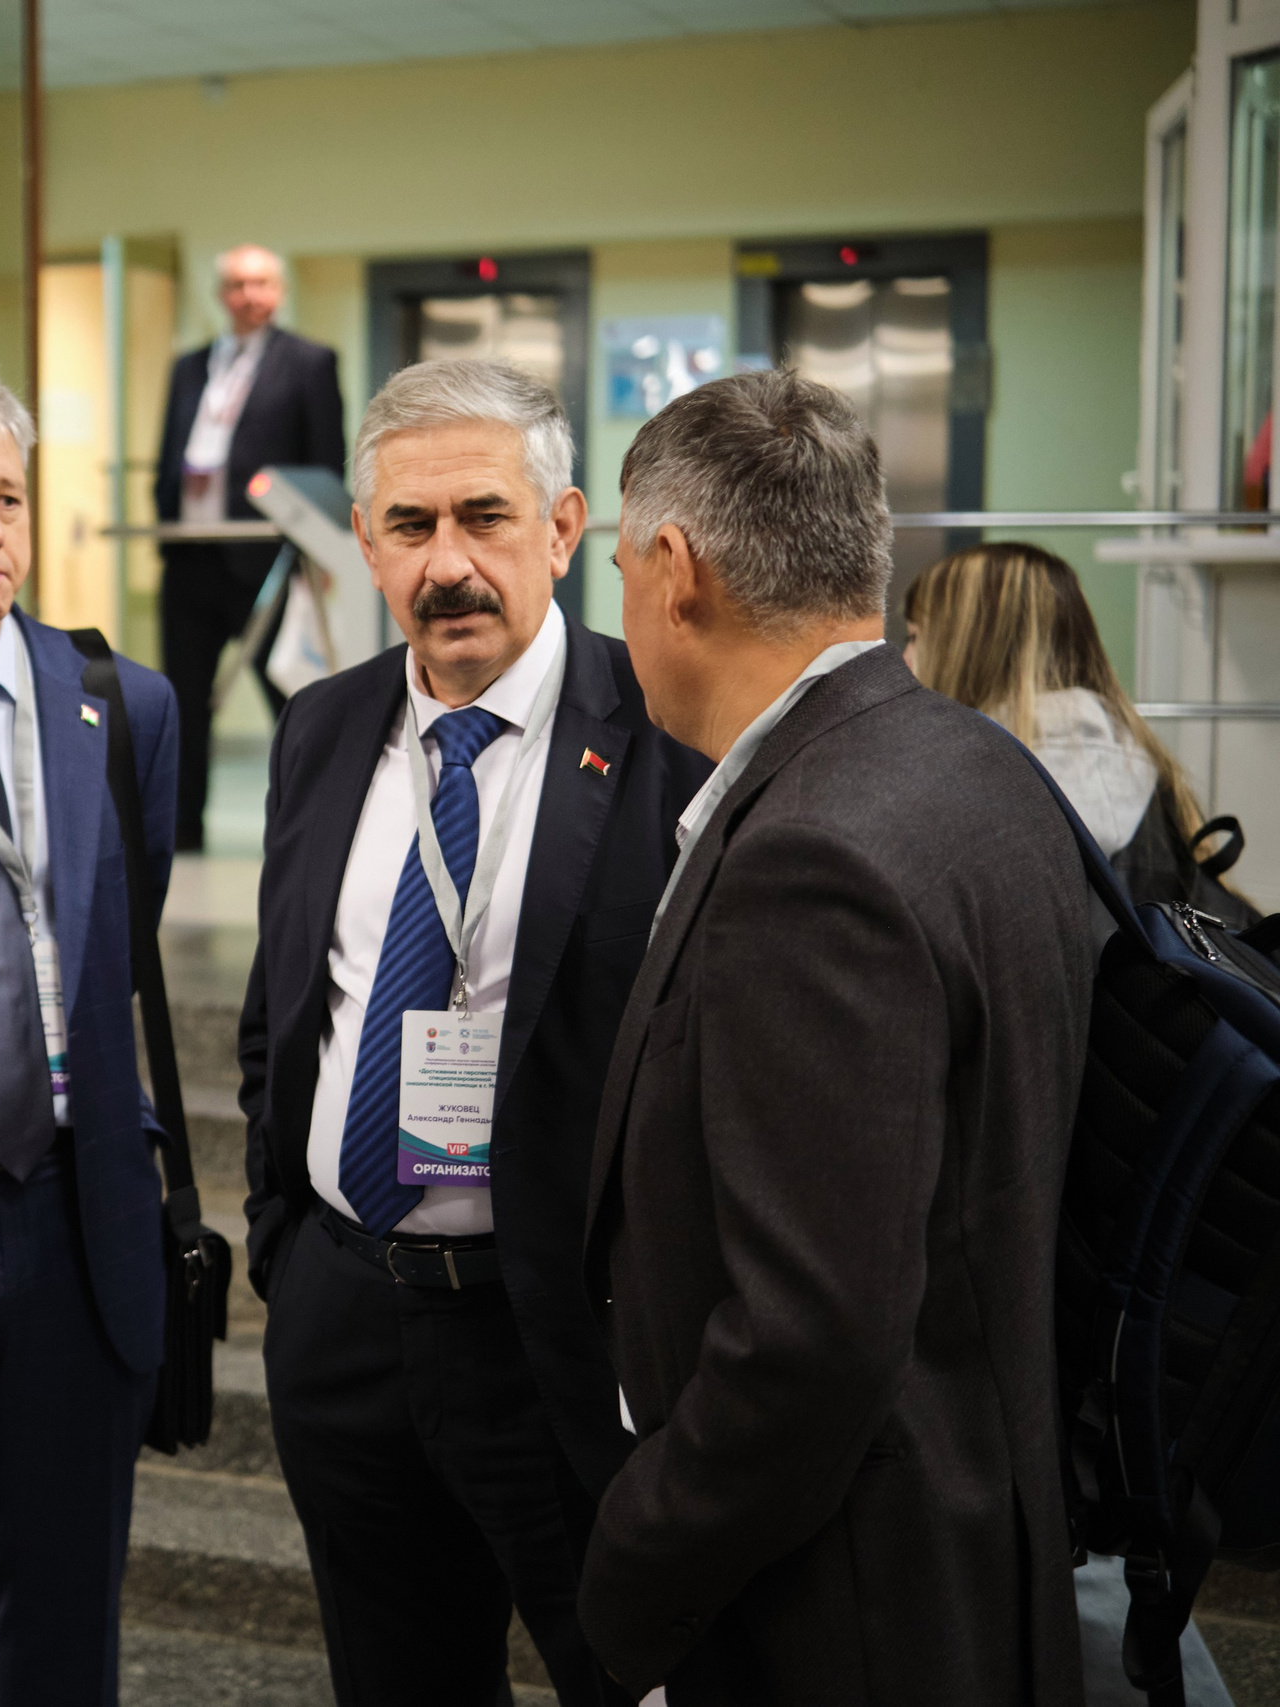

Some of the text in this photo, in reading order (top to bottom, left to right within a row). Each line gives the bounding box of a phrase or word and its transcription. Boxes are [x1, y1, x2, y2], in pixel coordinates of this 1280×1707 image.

[438, 1105, 479, 1114] ЖУКОВЕЦ
[407, 1114, 454, 1124] Александр
[448, 1144, 468, 1154] VIP
